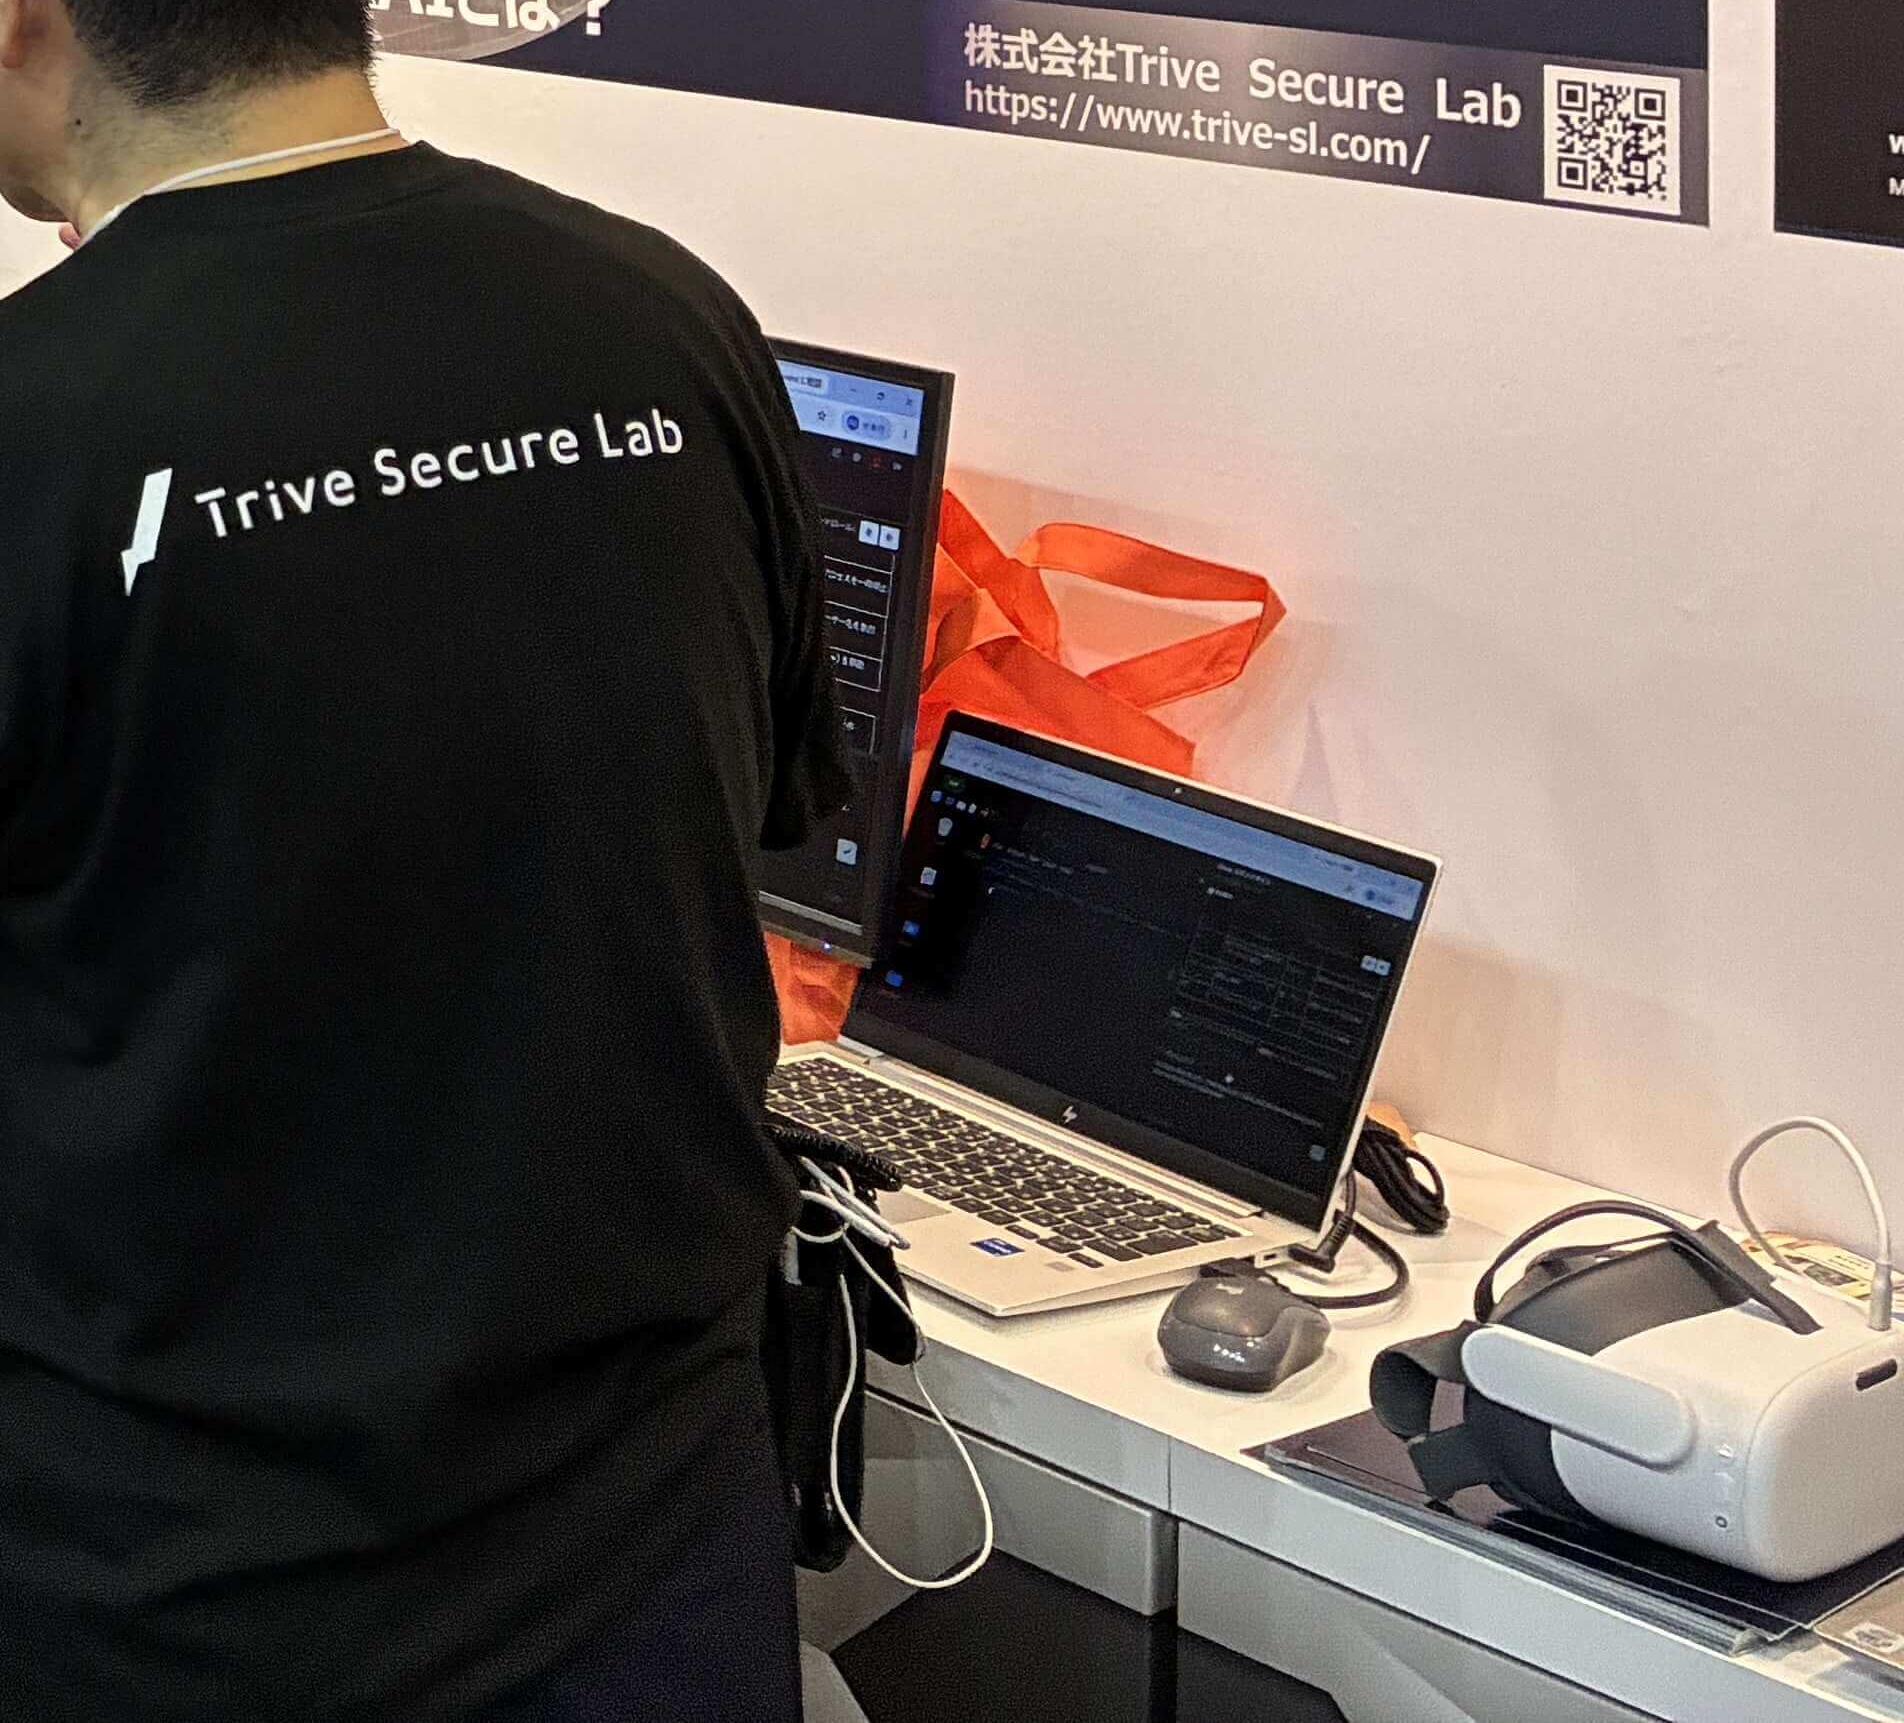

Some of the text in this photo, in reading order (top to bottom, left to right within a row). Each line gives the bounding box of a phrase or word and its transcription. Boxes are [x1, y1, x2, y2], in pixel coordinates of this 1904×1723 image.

[963, 23, 1523, 132] 株式会社Trive Secure Lab
[963, 79, 1431, 173] https://www.trive-sl.com/
[194, 407, 684, 538] Trive Secure Lab
